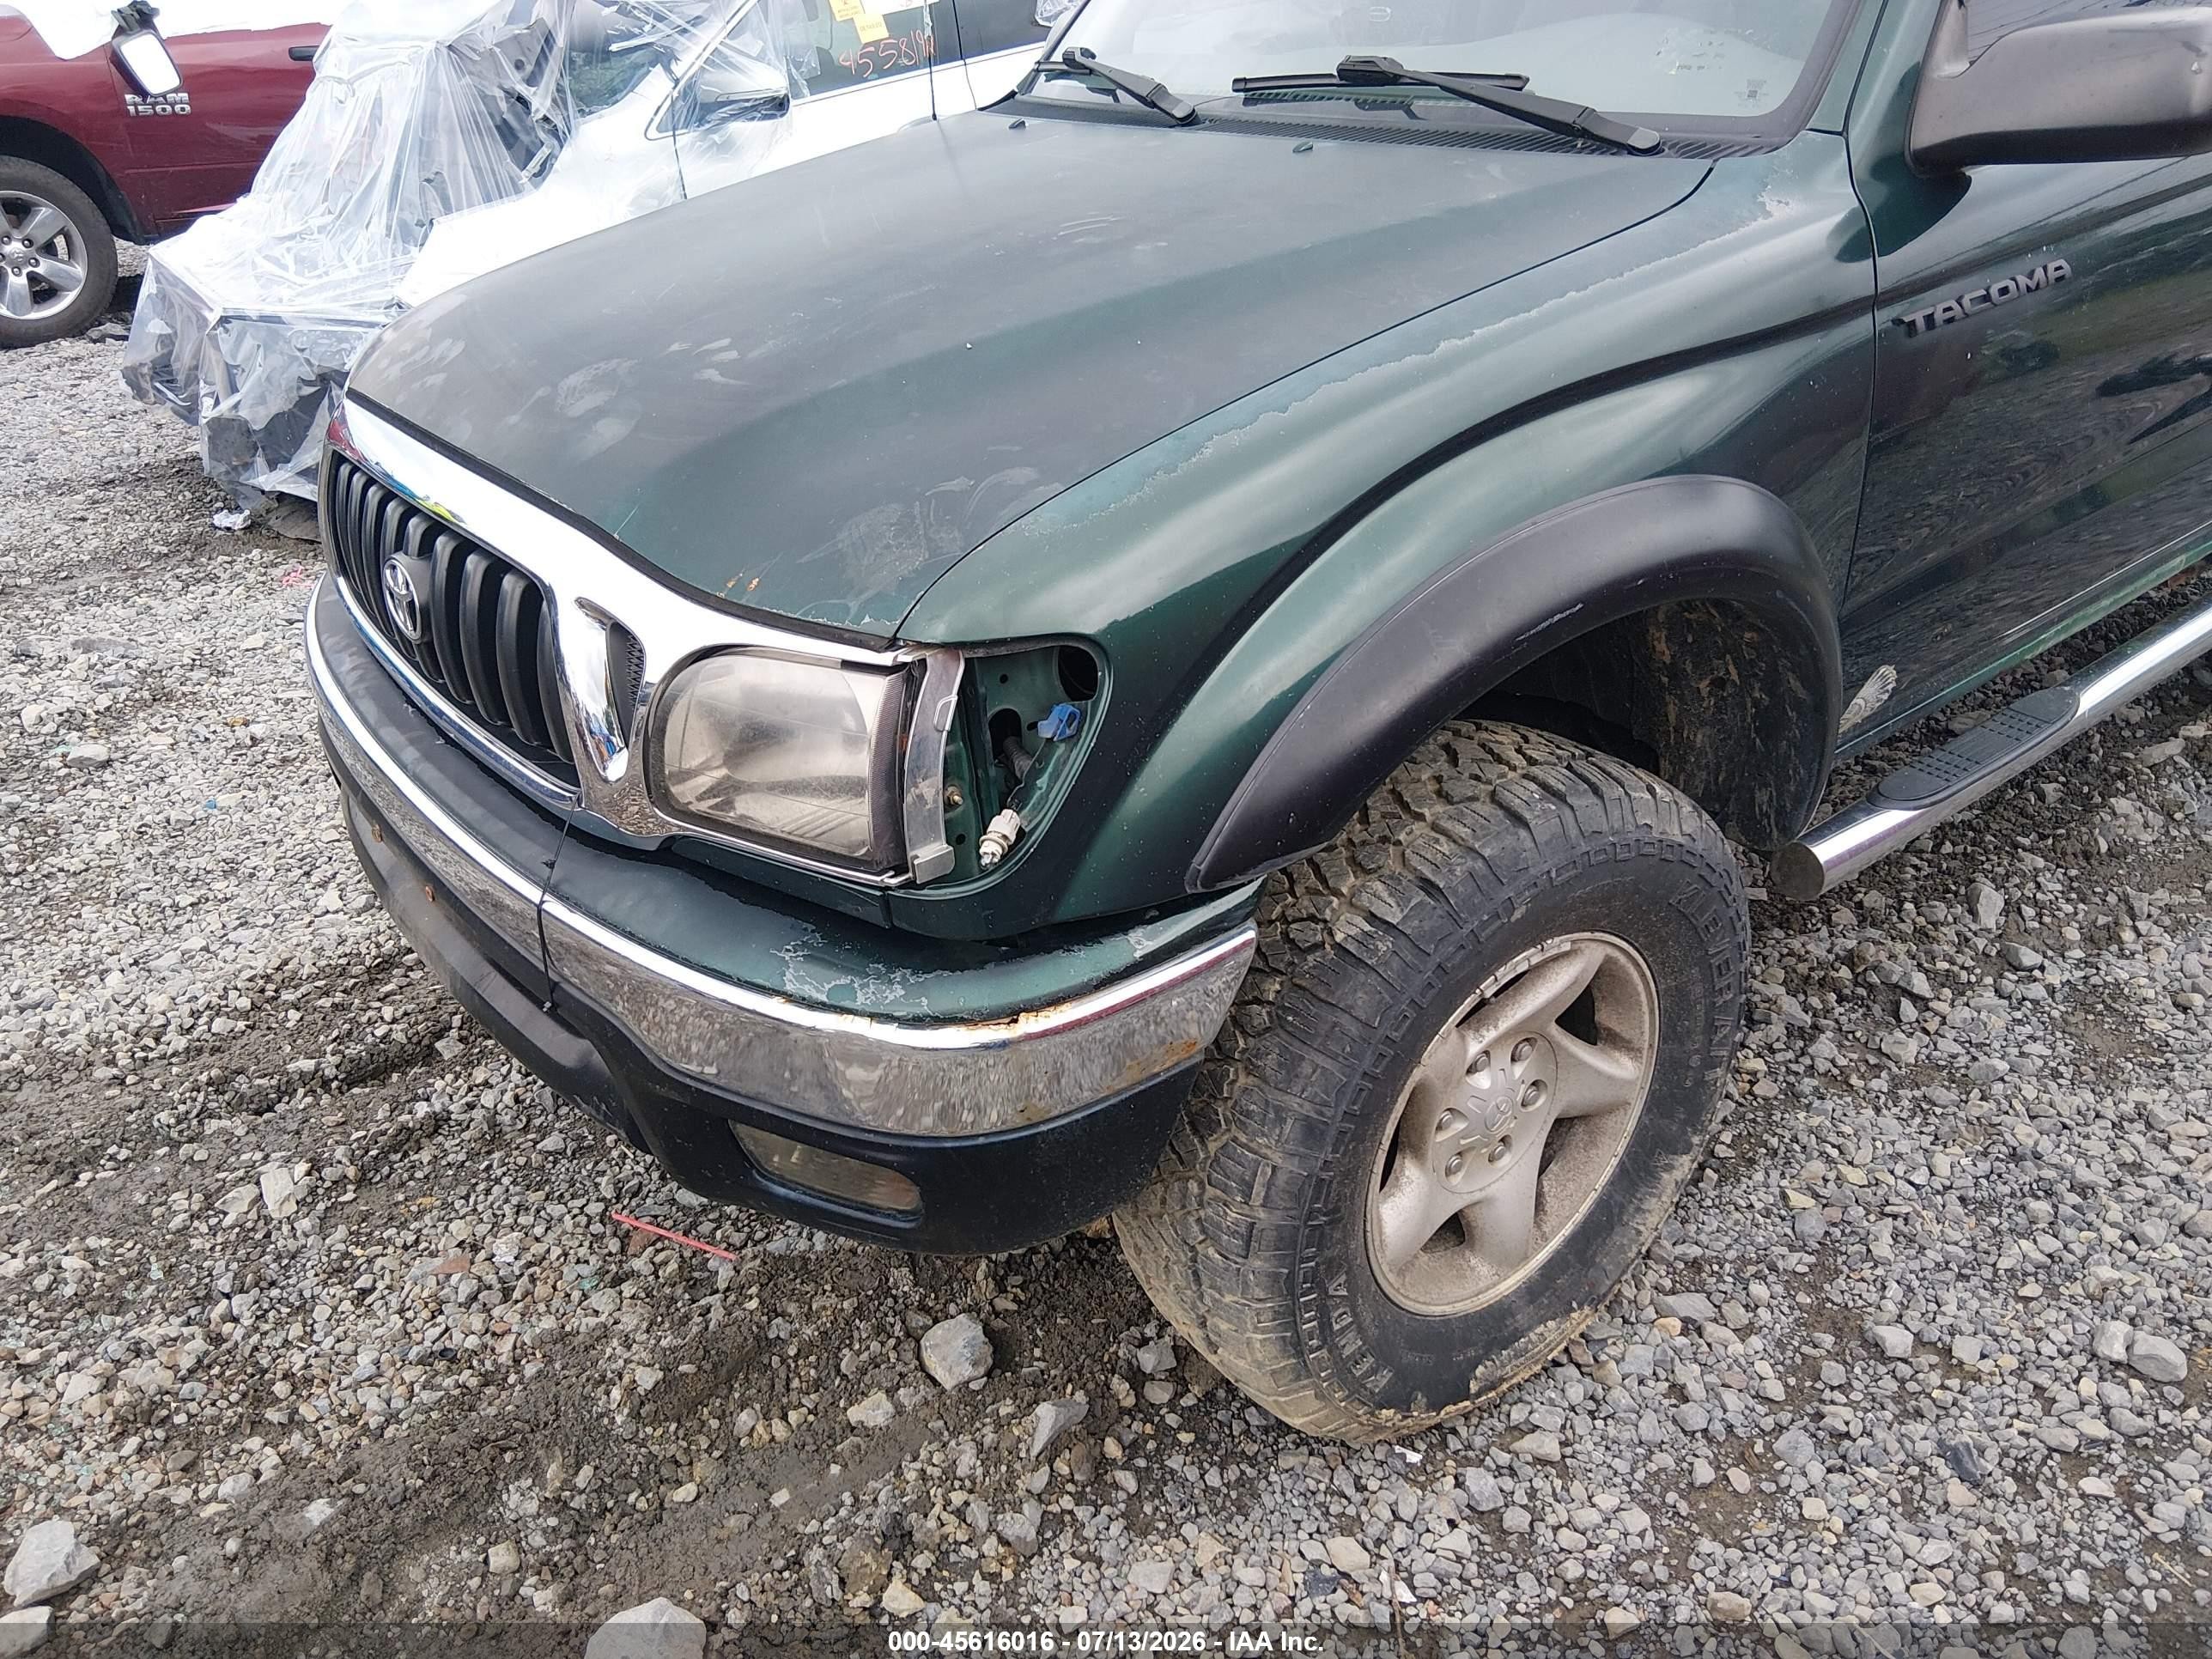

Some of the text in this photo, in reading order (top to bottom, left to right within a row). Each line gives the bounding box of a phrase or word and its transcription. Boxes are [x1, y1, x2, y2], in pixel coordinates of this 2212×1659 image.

[125, 93, 189, 104] RAM
[127, 104, 191, 116] 1500
[1899, 258, 2072, 337] TACOMA
[1328, 1270, 1395, 1393] KENDA
